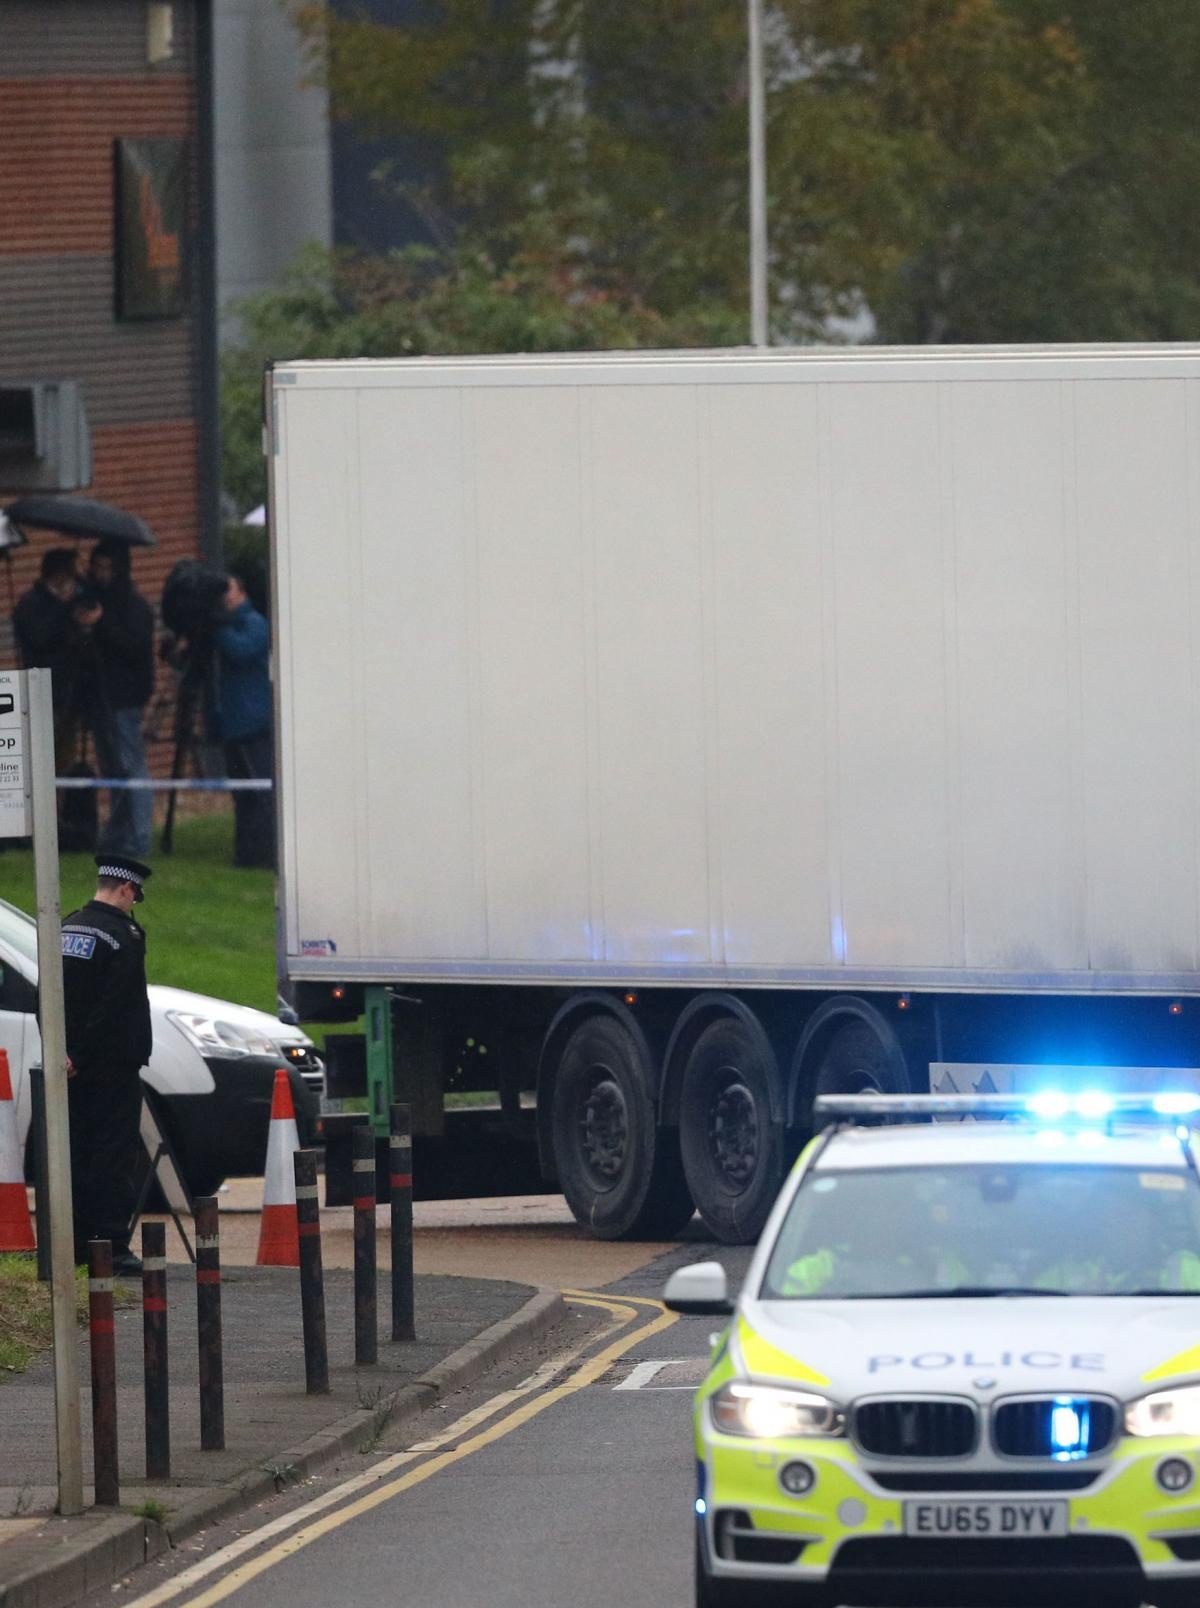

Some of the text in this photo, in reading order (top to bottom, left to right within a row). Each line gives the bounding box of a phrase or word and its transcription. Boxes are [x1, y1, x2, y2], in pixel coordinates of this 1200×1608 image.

[867, 1352, 1106, 1373] POLICE
[916, 1506, 1055, 1532] EU65 DYV
